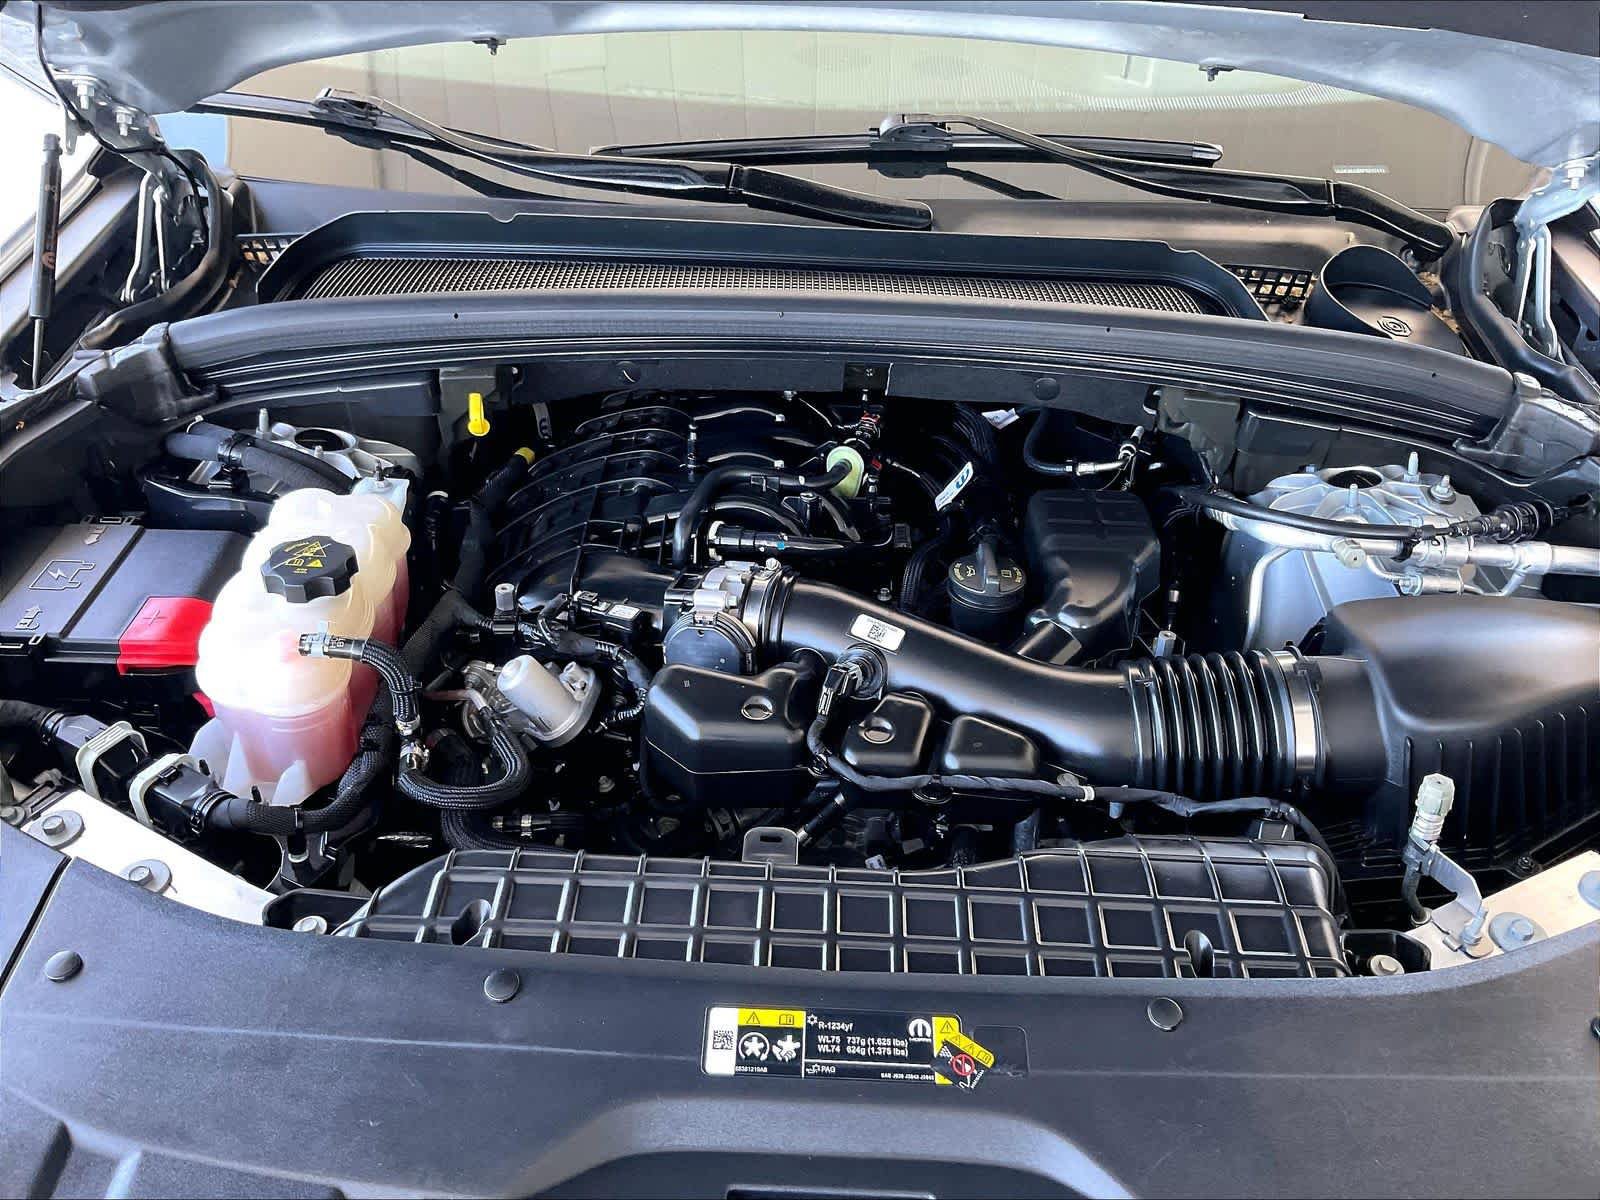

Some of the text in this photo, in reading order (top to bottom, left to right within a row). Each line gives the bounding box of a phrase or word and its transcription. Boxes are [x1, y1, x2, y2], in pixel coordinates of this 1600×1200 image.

[818, 1021, 854, 1032] R-1234yf
[817, 1035, 909, 1048] WL75 737g (1.625 lbs)
[817, 1044, 909, 1058] WL74 624g (1.375 lbs)
[821, 1065, 836, 1073] PAG
